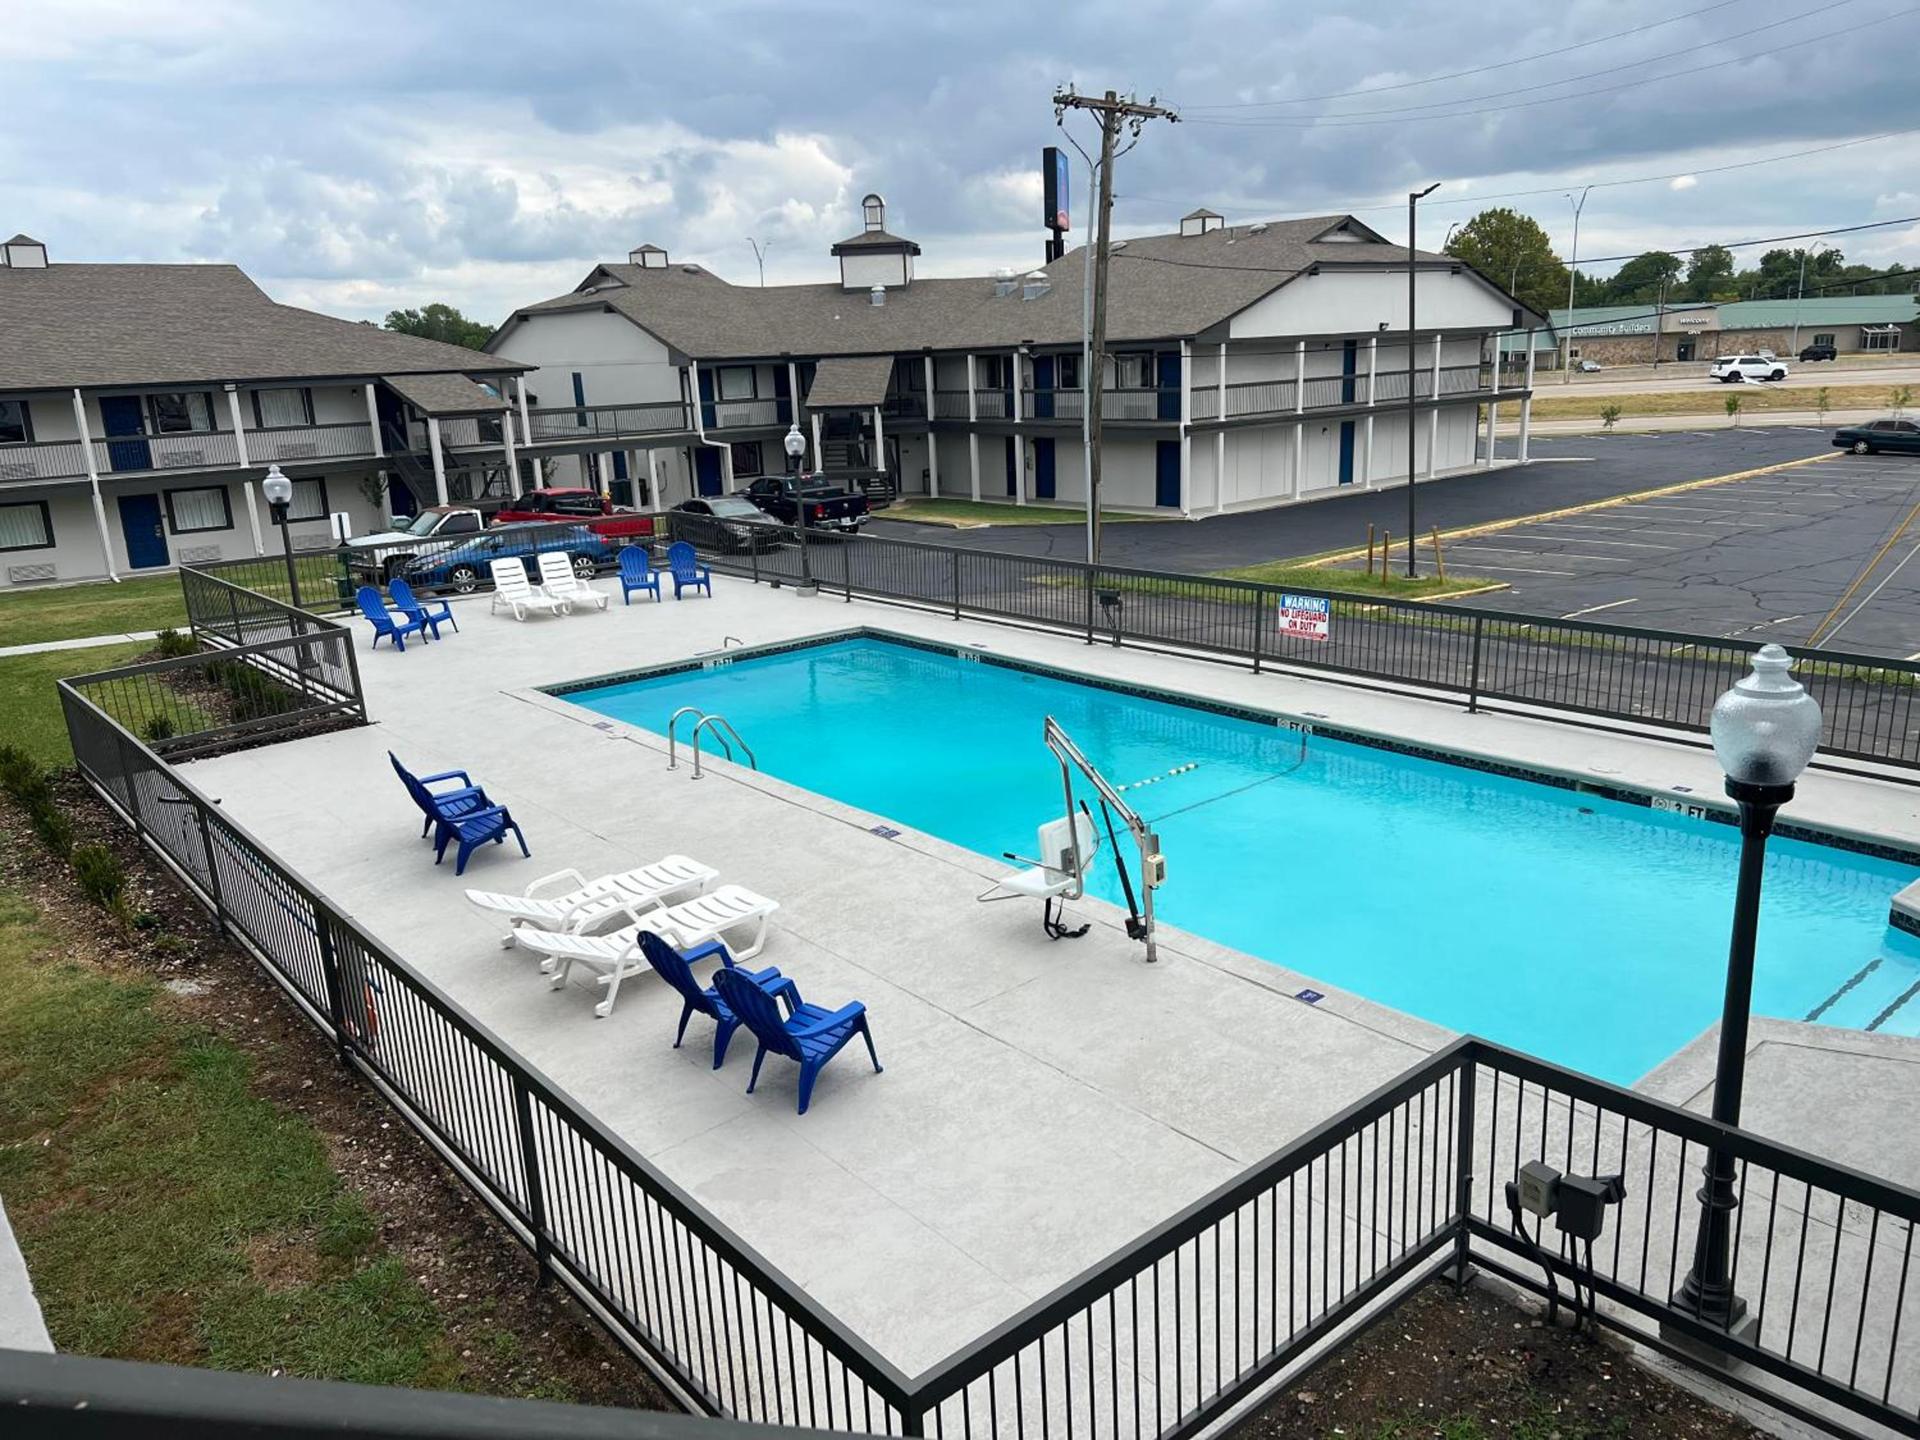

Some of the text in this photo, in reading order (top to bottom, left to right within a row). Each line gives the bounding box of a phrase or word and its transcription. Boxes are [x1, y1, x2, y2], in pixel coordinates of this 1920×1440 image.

[1572, 322, 1651, 335] Community Builders
[1284, 596, 1326, 612] WARNING
[1280, 608, 1327, 622] NO LIFEGUARD
[1288, 619, 1317, 631] ON DUTY
[1687, 805, 1705, 819] FT
